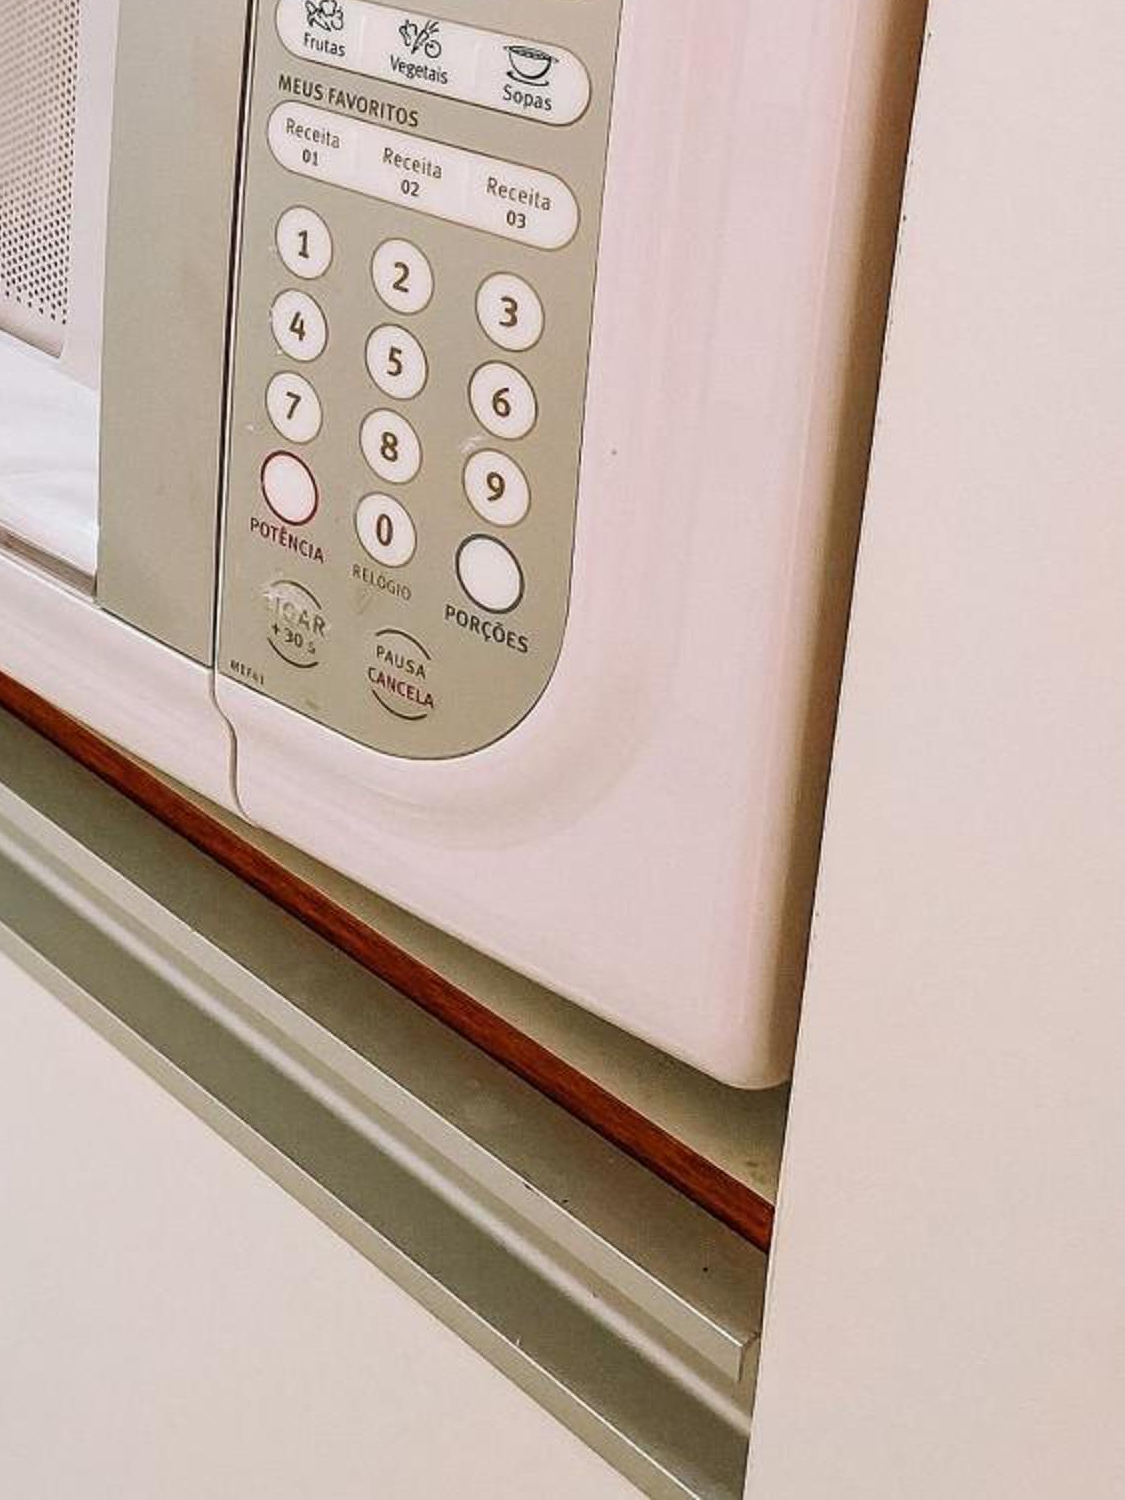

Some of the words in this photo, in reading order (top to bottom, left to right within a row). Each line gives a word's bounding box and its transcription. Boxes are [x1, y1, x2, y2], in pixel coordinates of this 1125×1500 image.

[278, 74, 324, 100] MEUS
[327, 86, 419, 128] FAVORITOS
[303, 32, 347, 58] Frutas
[390, 54, 449, 85] Vegetais
[502, 85, 553, 112] Sopas
[286, 117, 341, 149] Receita
[383, 147, 443, 180] Receita
[487, 176, 551, 212] Receita
[302, 150, 320, 167] 01
[400, 178, 420, 197] 02
[506, 209, 527, 229] 03
[297, 230, 310, 259] 1
[392, 261, 411, 293] 2
[499, 296, 519, 328] 3
[289, 311, 307, 342] 4
[387, 346, 404, 377] 5
[491, 387, 512, 419] 6
[286, 391, 301, 421] 7
[380, 431, 399, 463] 8
[486, 471, 506, 503] 9
[250, 516, 325, 564] POTÊNCIA
[376, 513, 394, 547] 0
[444, 603, 529, 654] PORÇÕES
[368, 667, 435, 709] CANCELA
[376, 645, 427, 679] PAUSA
